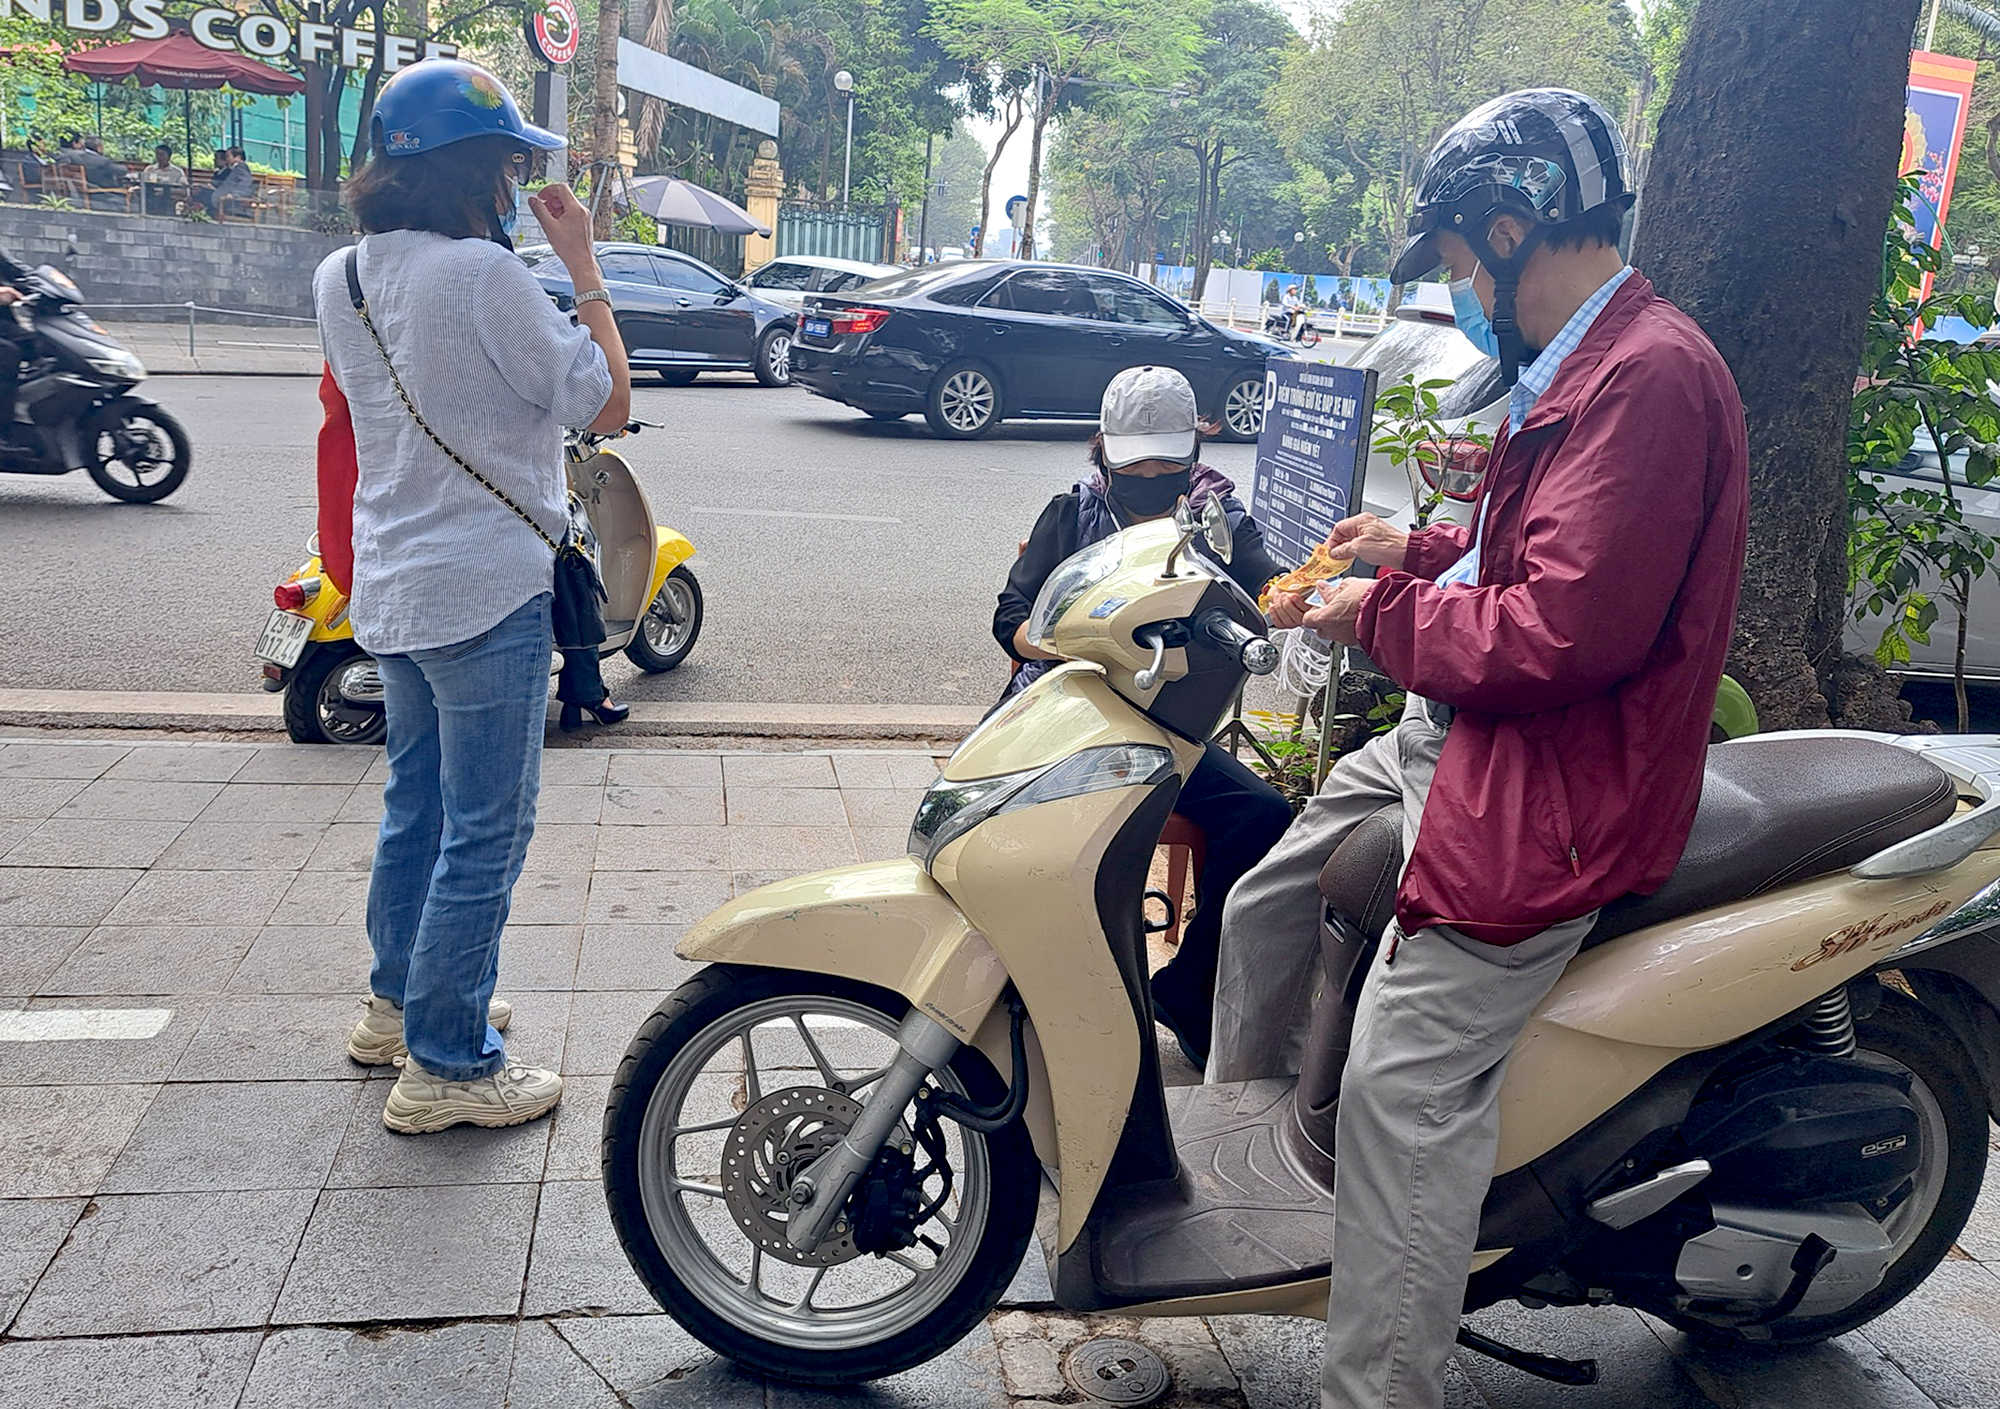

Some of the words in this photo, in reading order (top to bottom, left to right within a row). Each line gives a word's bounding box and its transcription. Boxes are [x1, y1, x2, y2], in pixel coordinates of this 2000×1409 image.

[541, 37, 573, 60] COFFEE
[1261, 370, 1277, 433] P
[270, 613, 306, 639] 29-AB
